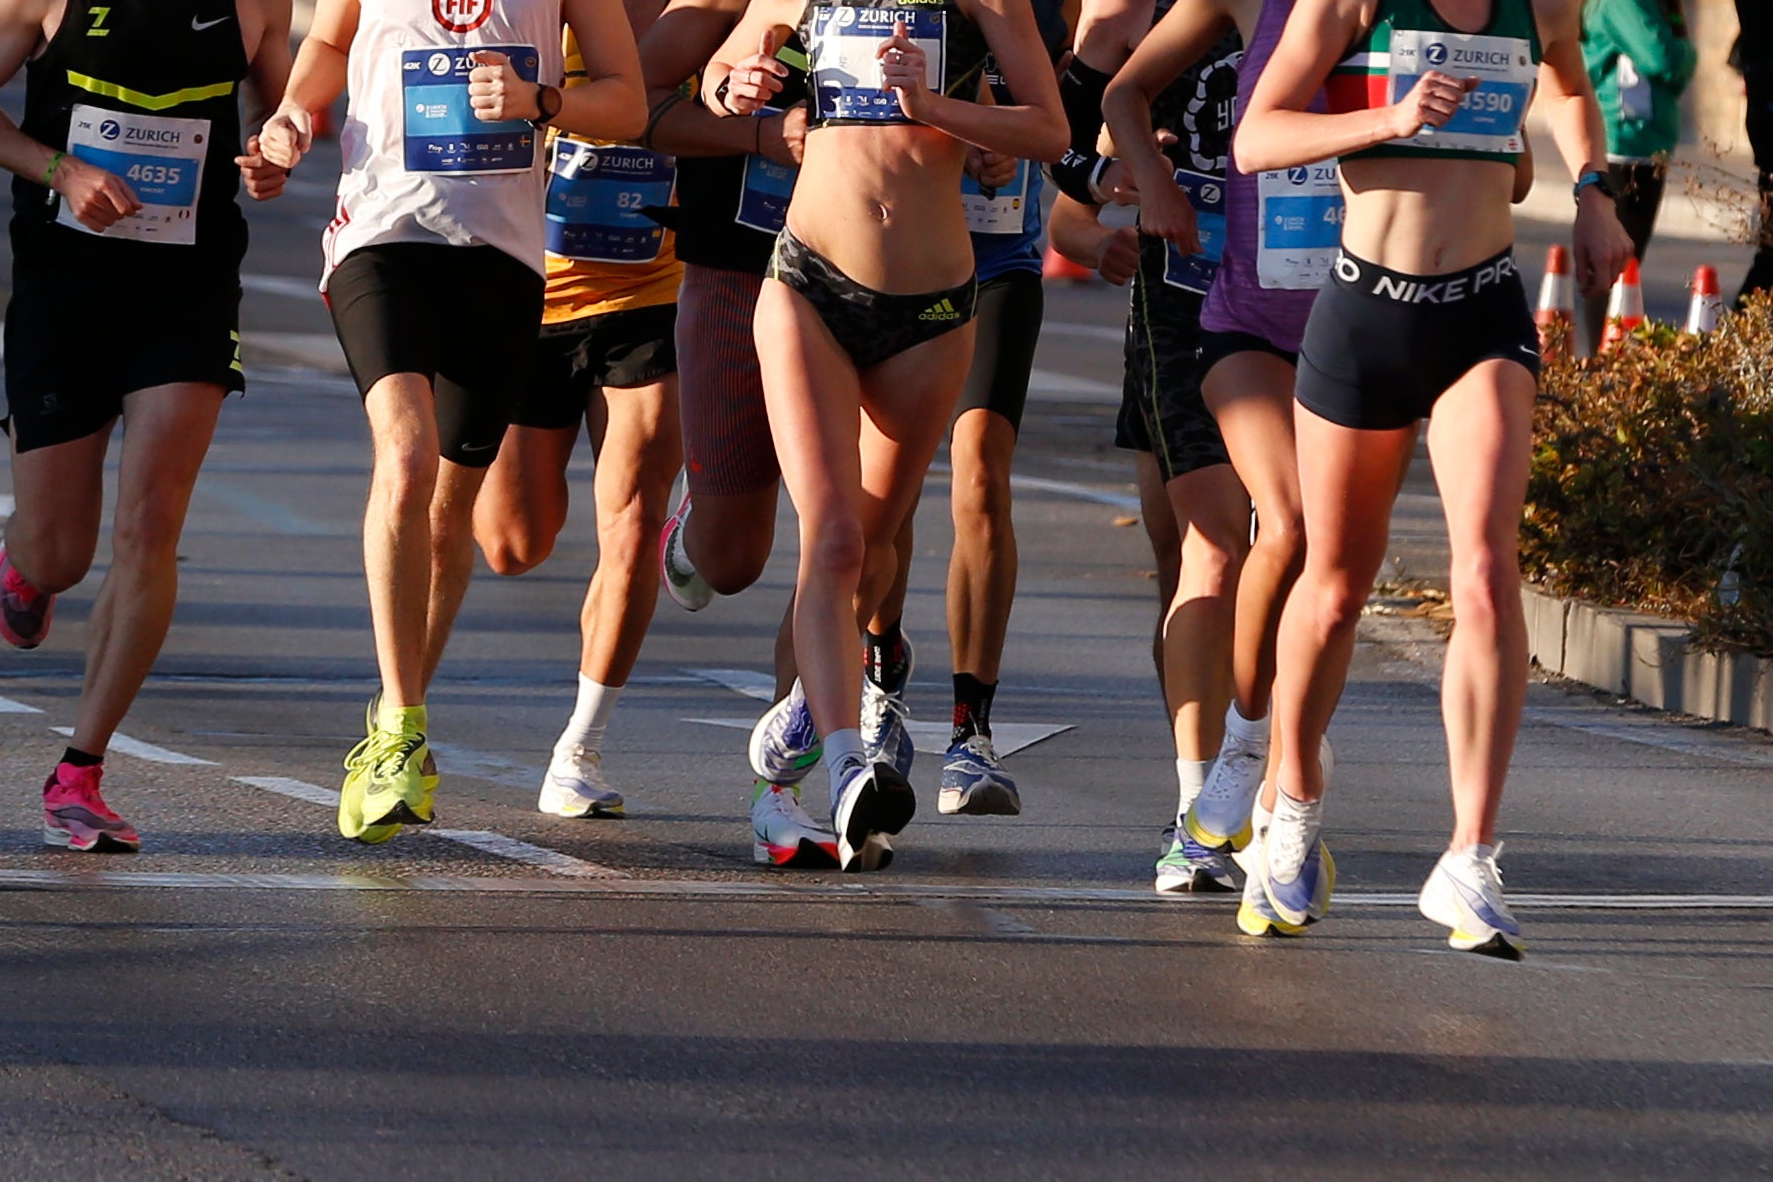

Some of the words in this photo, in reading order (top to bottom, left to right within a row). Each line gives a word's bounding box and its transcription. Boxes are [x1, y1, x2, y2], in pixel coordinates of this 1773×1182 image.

[858, 8, 916, 24] ZURICH
[1453, 49, 1511, 66] ZURICH
[125, 126, 181, 145] ZURICH
[602, 156, 655, 170] ZURICH
[126, 163, 182, 186] 4635
[616, 192, 644, 210] 82
[1372, 275, 1469, 304] NIKE
[919, 310, 961, 322] adidas
